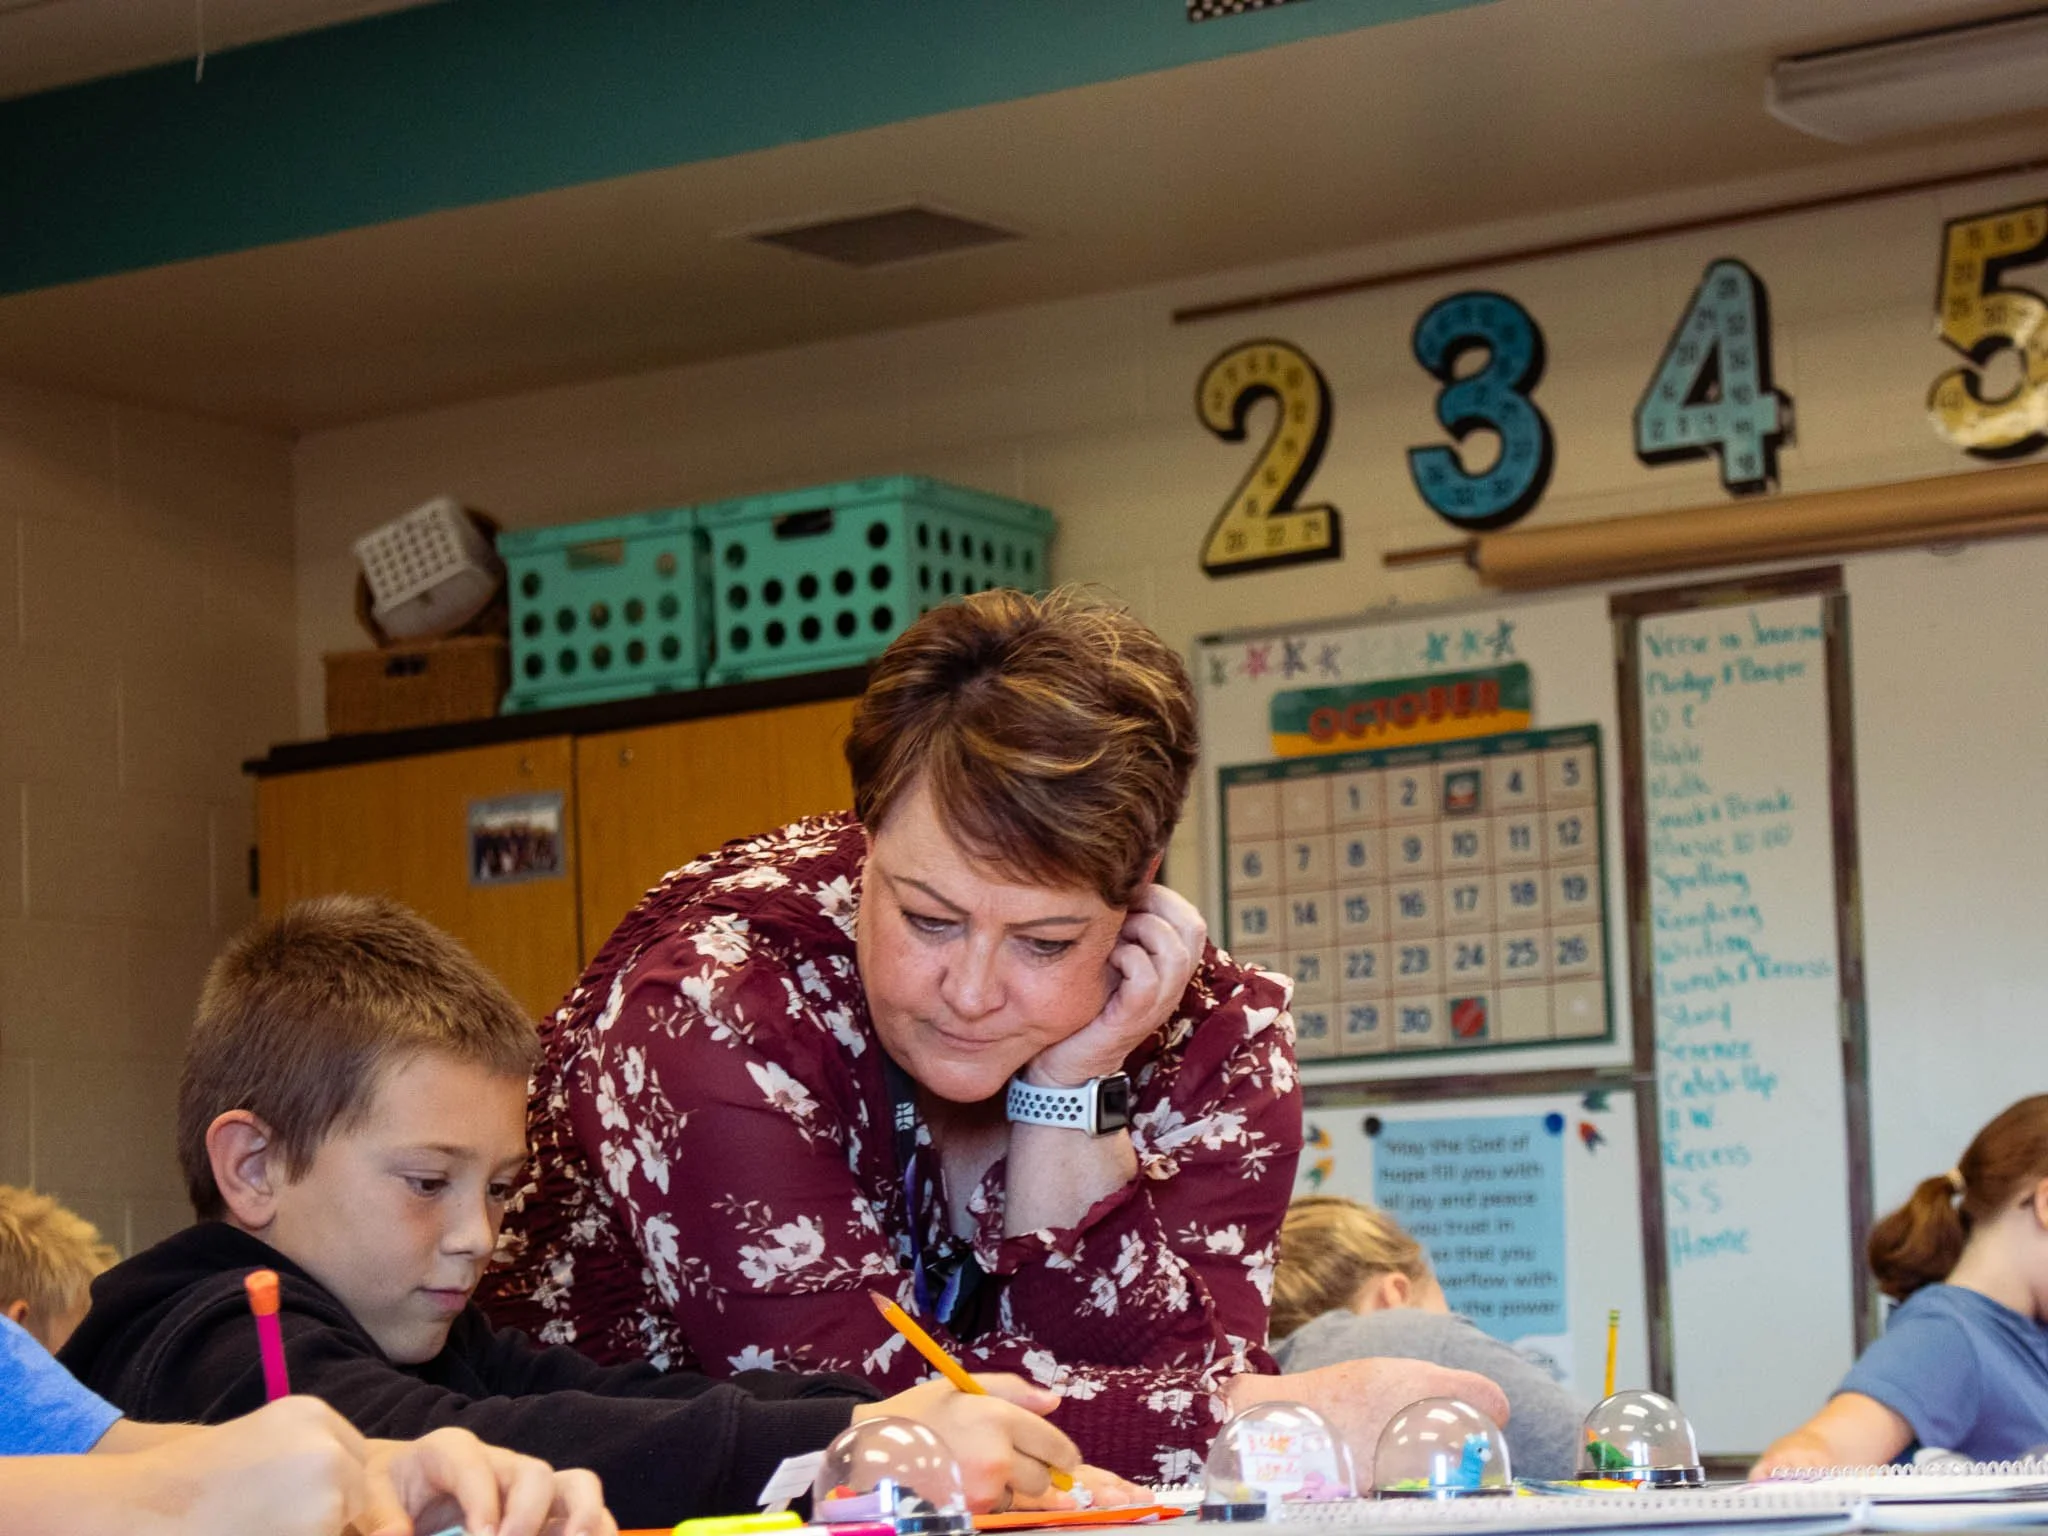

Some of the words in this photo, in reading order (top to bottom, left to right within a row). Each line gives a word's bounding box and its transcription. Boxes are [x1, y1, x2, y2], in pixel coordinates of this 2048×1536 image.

[1932, 201, 2048, 460] 5
[1637, 256, 1790, 496] 4
[1409, 289, 1556, 533] 3
[1196, 338, 1342, 578] 2
[1308, 679, 1501, 743] OCTOBER
[1347, 784, 1361, 811] 1
[1401, 778, 1417, 807] 2
[1507, 770, 1524, 794] 4
[1562, 757, 1581, 787] 5
[1242, 851, 1262, 878] 6
[1295, 843, 1312, 871] 7
[1347, 840, 1366, 867] 8
[1402, 836, 1422, 863] 9
[1451, 830, 1479, 858] 10
[1508, 825, 1531, 850] 11
[1556, 817, 1582, 846] 12
[1241, 907, 1268, 934] 13
[1293, 902, 1318, 925] 14
[1344, 895, 1370, 923] 15
[1398, 891, 1426, 918] 16
[1452, 884, 1480, 911] 17
[1510, 880, 1537, 906] 18
[1561, 875, 1589, 901] 19
[1295, 955, 1320, 983] 21
[1346, 950, 1376, 980] 22
[1399, 946, 1430, 975] 23
[1455, 944, 1485, 971] 24
[1506, 938, 1539, 969] 25
[1557, 936, 1588, 966] 26
[1297, 1012, 1328, 1039] 28
[1347, 1005, 1379, 1034] 29
[1401, 1007, 1432, 1034] 30
[1430, 1137, 1461, 1155] the
[1467, 1135, 1507, 1153] God
[1512, 1133, 1531, 1151] of
[1663, 1139, 1752, 1170] Recess
[1461, 1167, 1496, 1185] you
[1502, 1161, 1545, 1180] with
[1440, 1191, 1476, 1208] and
[1501, 1248, 1537, 1267] you
[1670, 1228, 1748, 1267] Home
[1513, 1270, 1558, 1287] with
